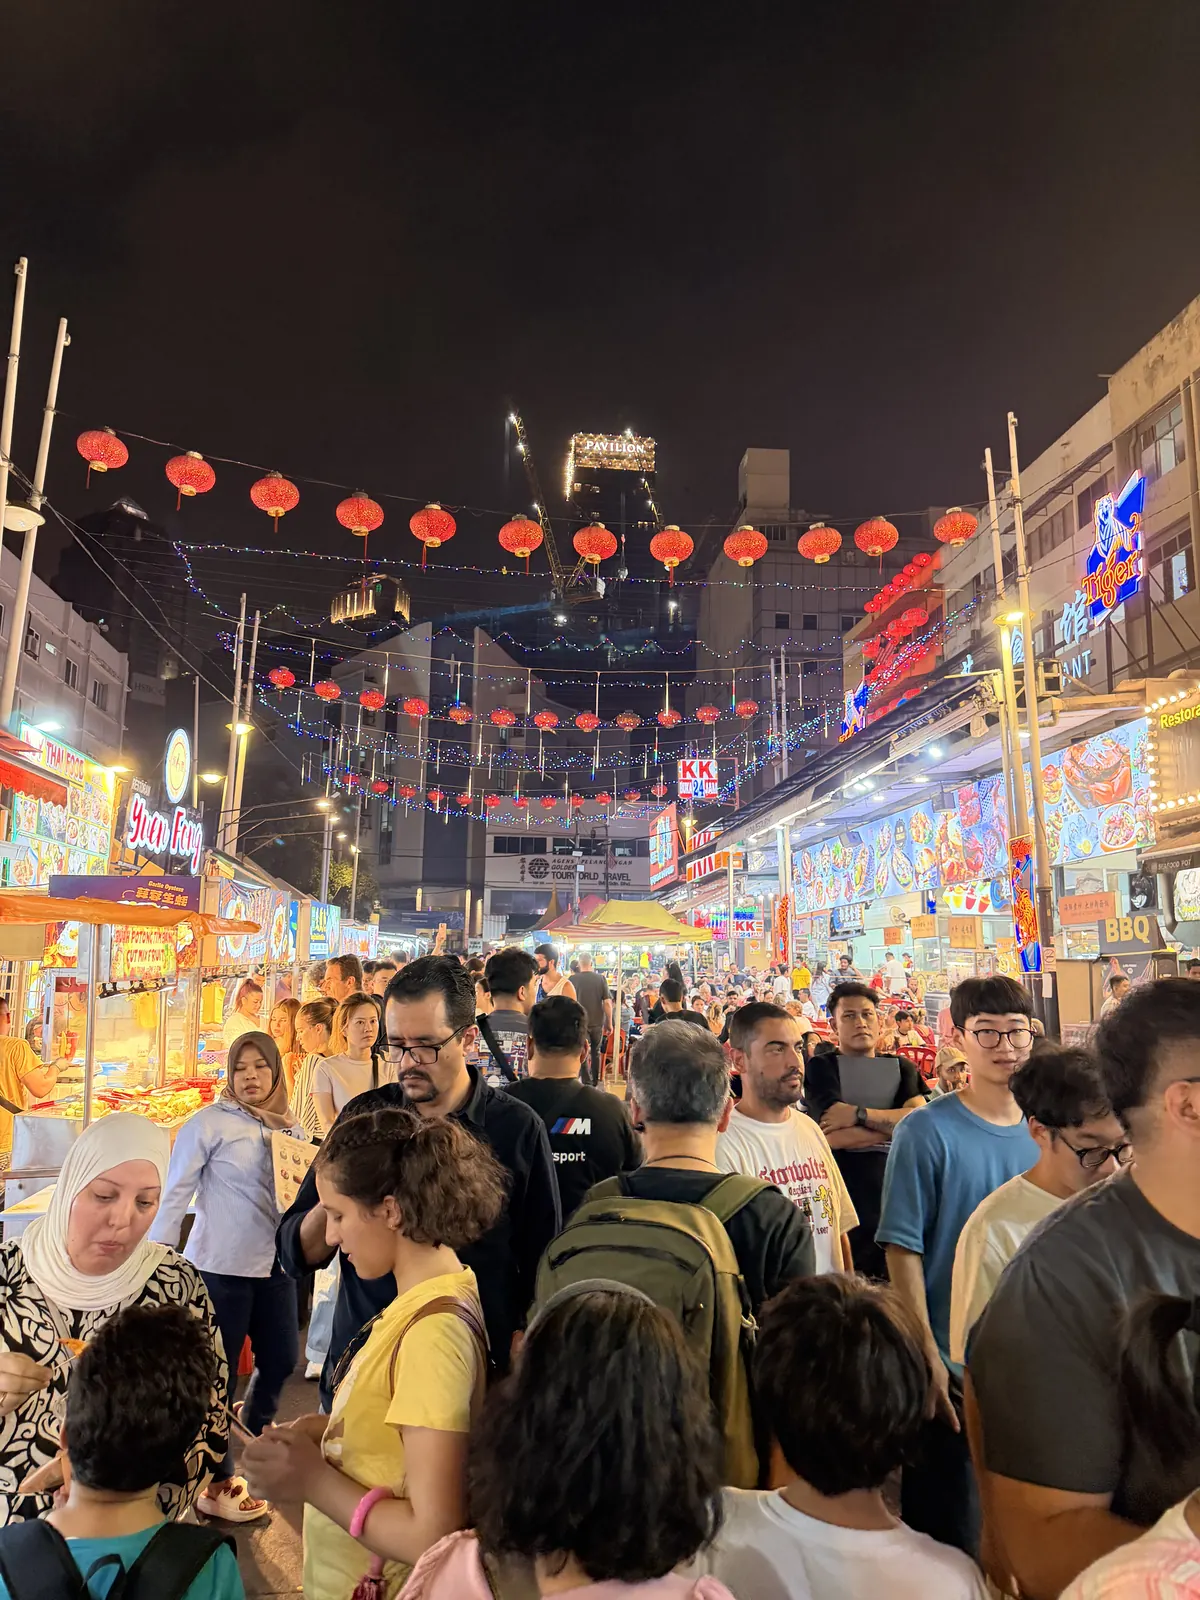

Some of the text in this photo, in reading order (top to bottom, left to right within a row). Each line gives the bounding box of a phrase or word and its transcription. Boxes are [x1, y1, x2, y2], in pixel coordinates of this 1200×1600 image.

[585, 441, 645, 453] PAVILION
[1082, 551, 1138, 608] Tiger
[65, 752, 84, 780] FOOD
[682, 760, 714, 779] KK
[693, 779, 704, 797] 24
[704, 781, 718, 795] JAM
[128, 796, 169, 853] Yuen
[1181, 858, 1191, 867] POT
[602, 872, 631, 881] TRAVEL
[148, 880, 184, 893] Garlic Oysters
[736, 921, 755, 932] KK
[1105, 915, 1150, 944] BBQ
[127, 949, 138, 963] CUT
